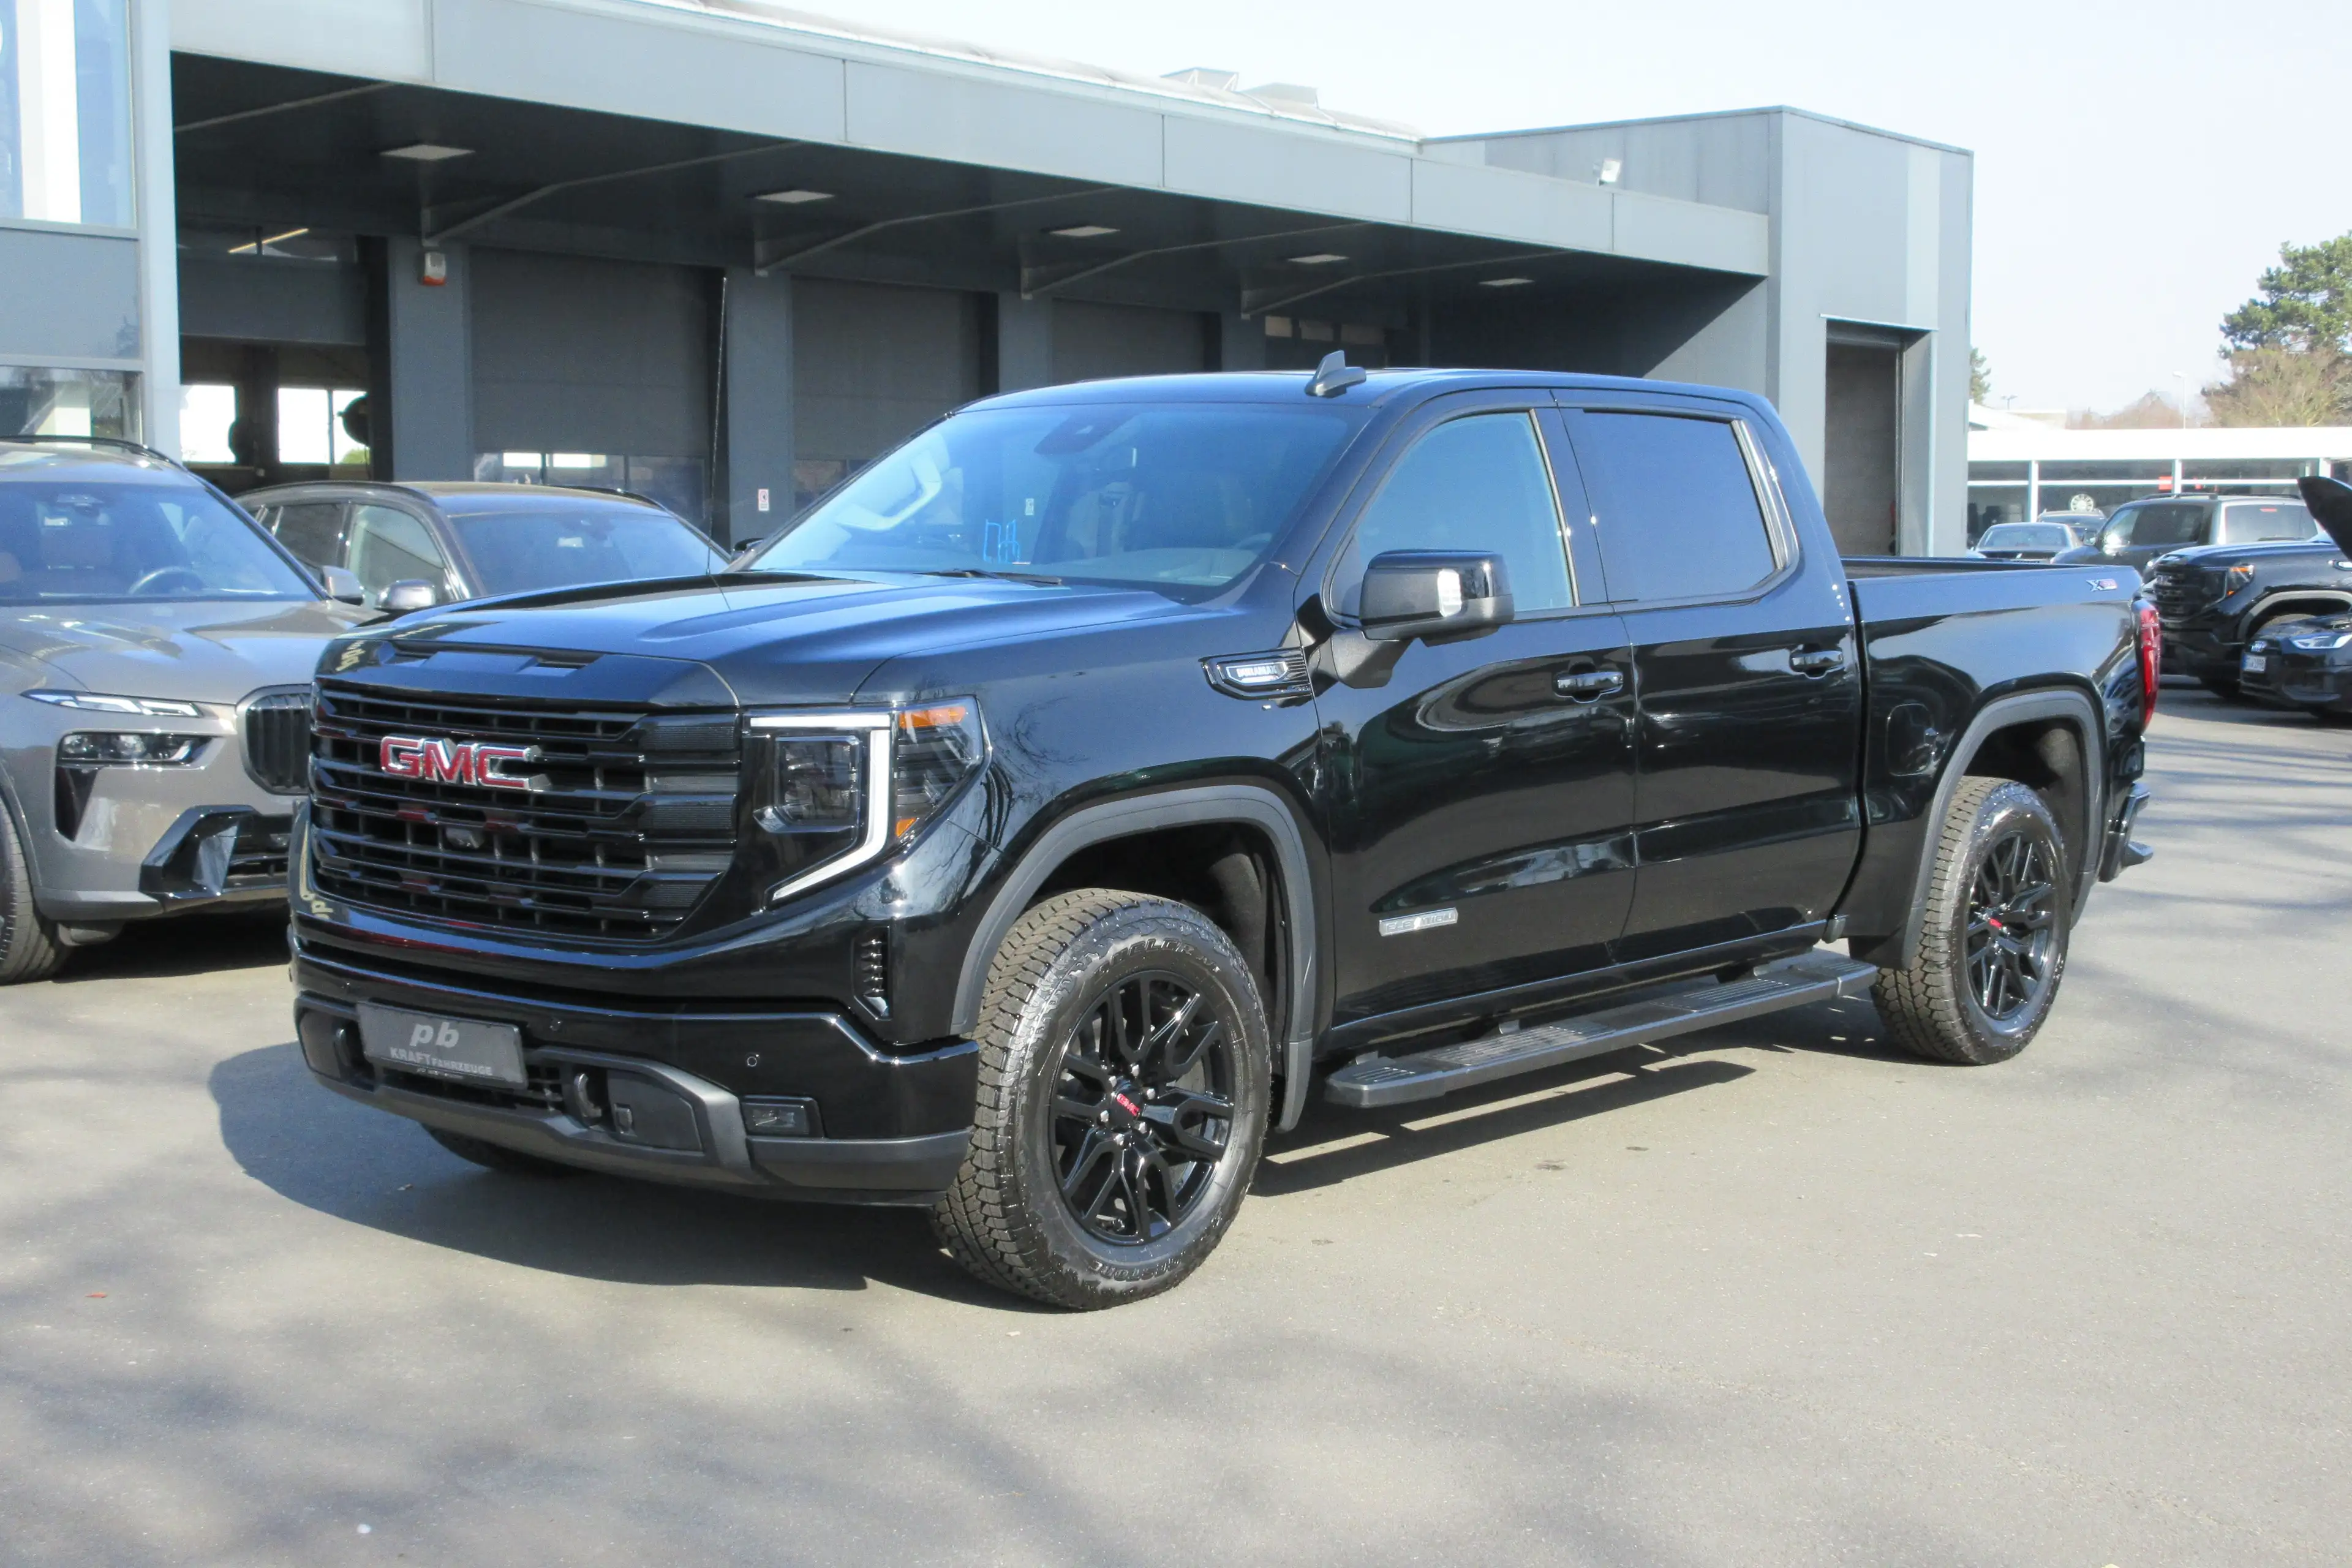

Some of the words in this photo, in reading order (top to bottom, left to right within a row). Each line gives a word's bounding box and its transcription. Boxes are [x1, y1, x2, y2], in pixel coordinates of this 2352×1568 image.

[380, 734, 552, 791] GMC
[409, 1021, 459, 1048] pb
[389, 1046, 493, 1076] KRAFTFAHRZEUGE
